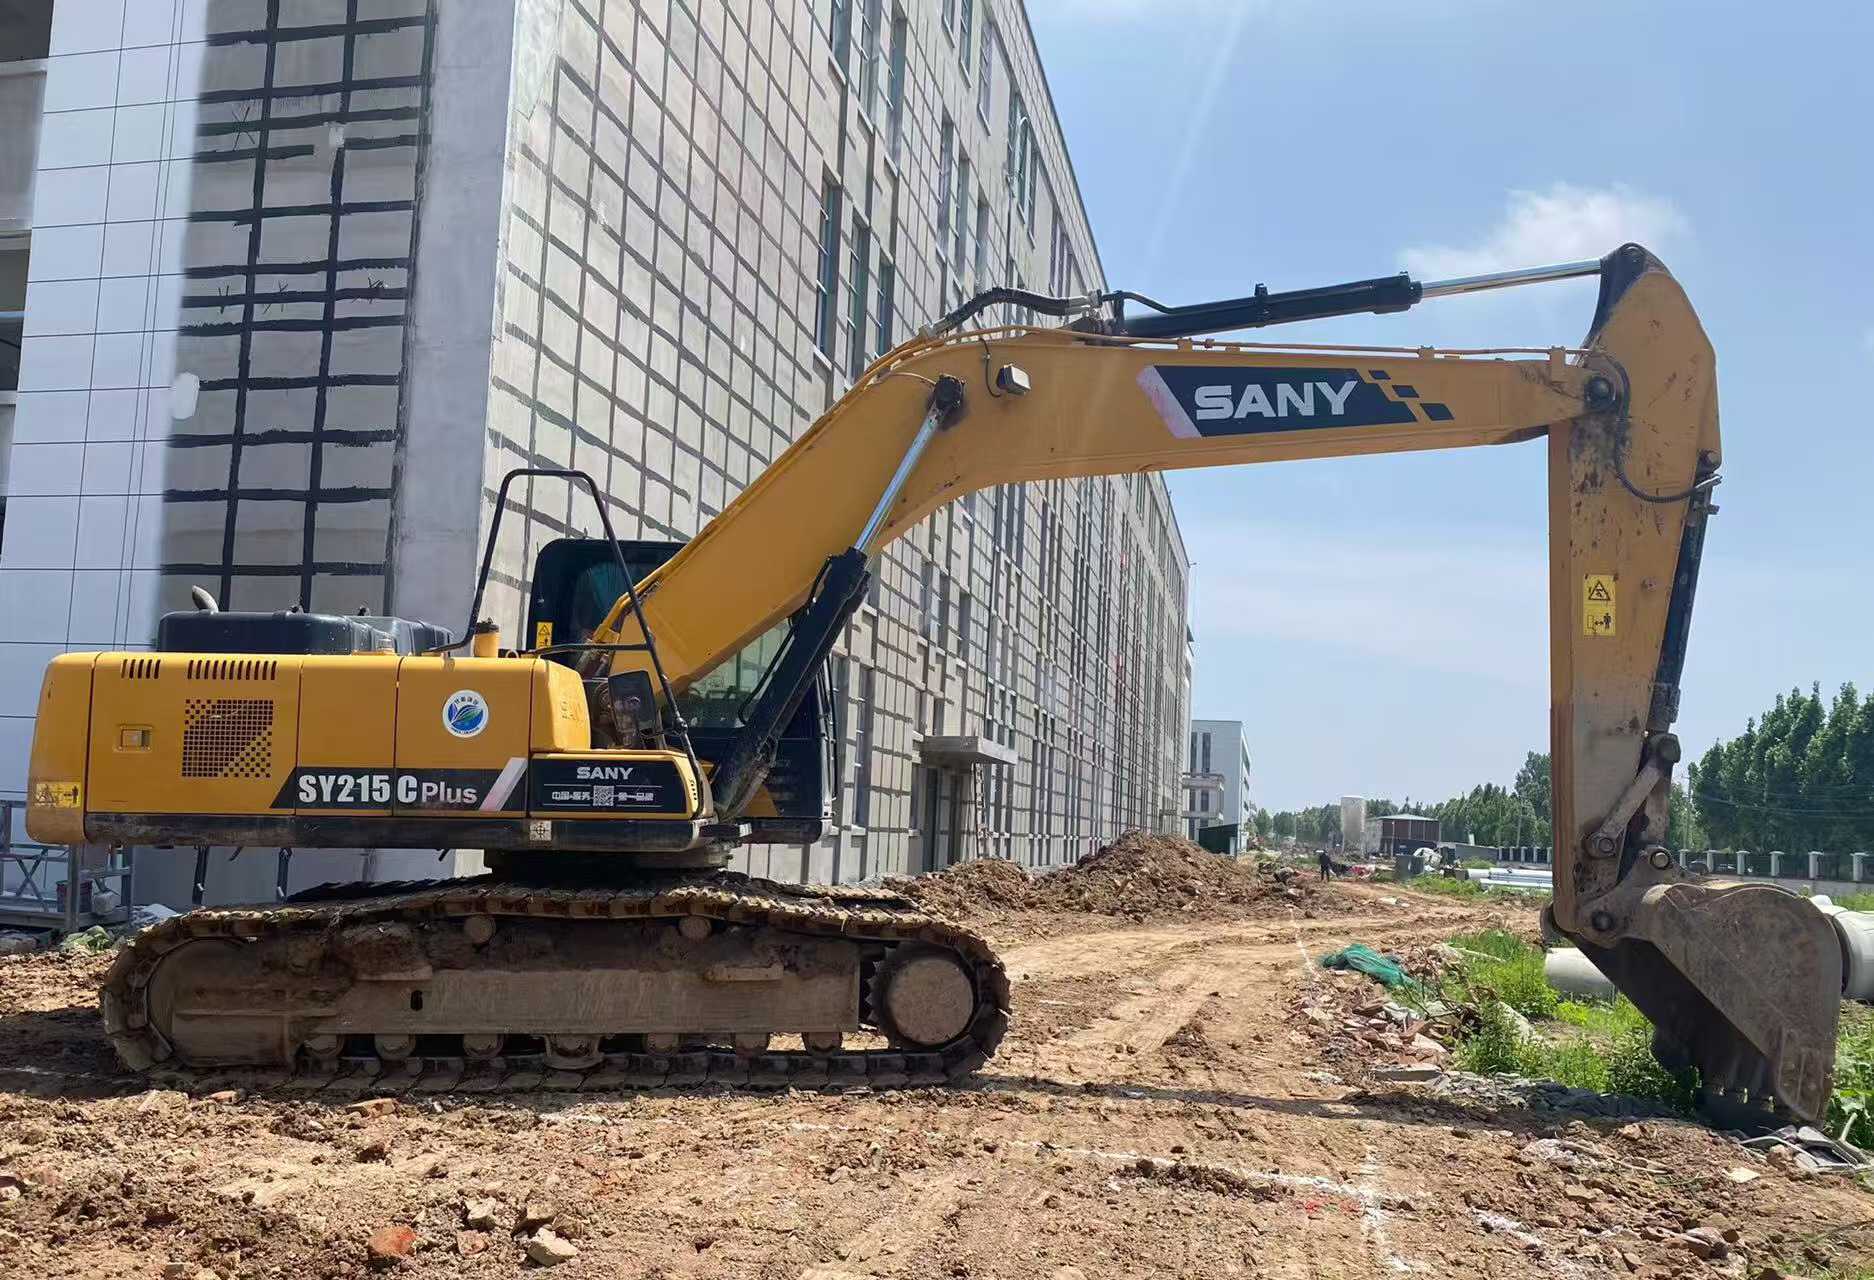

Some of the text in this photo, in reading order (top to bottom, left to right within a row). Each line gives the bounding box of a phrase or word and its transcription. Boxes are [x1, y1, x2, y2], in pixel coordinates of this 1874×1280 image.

[1194, 380, 1358, 421] SANY
[576, 766, 633, 780] SANY
[421, 781, 478, 805] Plus
